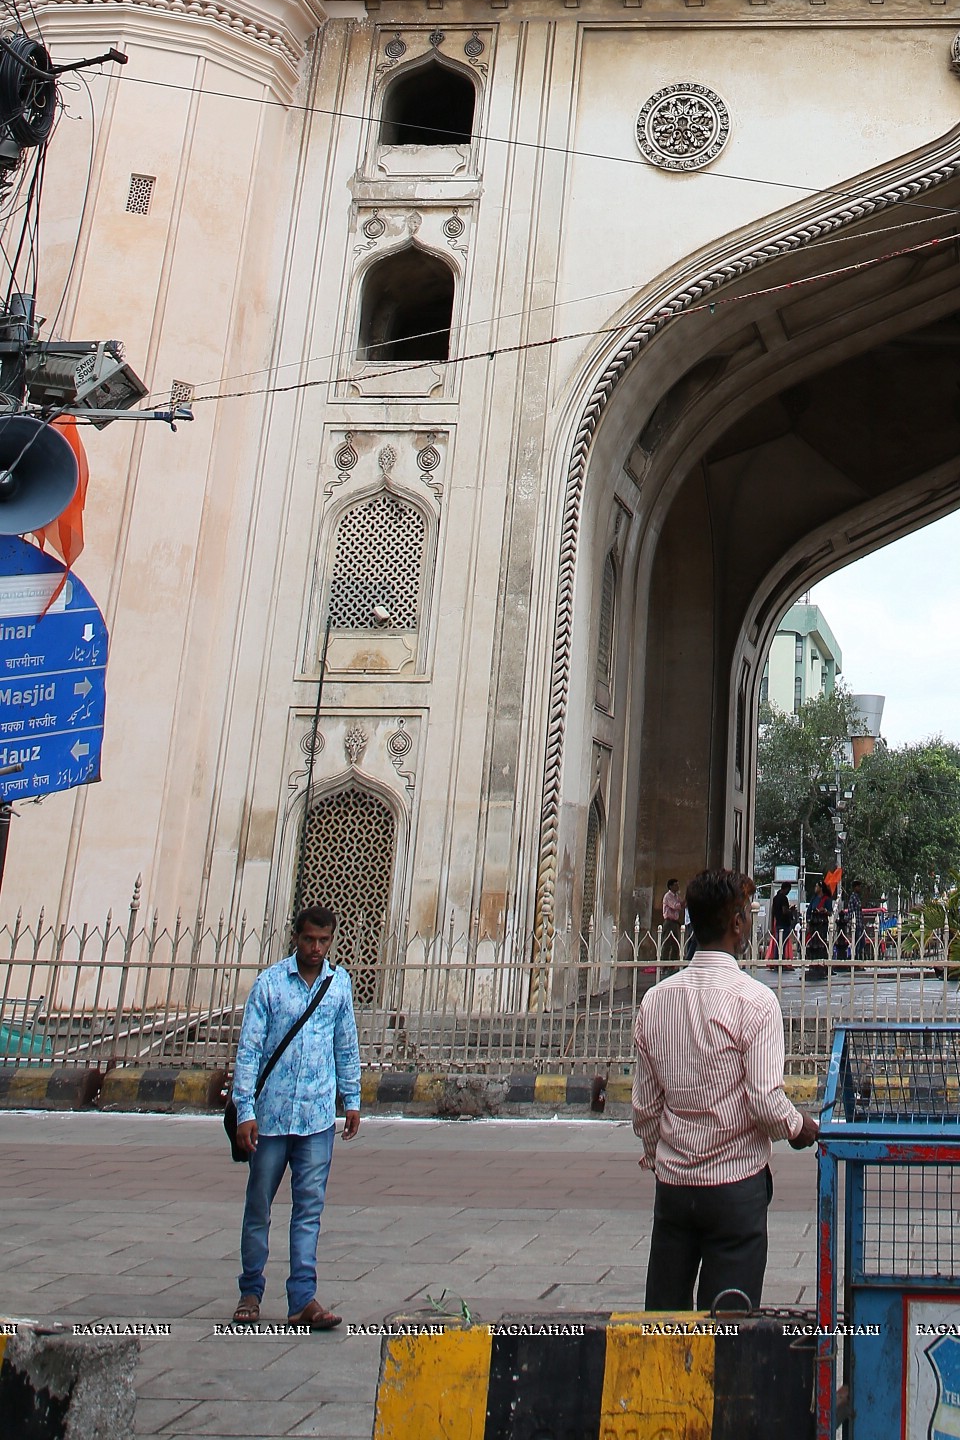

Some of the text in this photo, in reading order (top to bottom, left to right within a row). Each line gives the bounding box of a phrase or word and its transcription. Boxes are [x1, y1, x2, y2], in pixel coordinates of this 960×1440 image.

[76, 355, 97, 374] SAYEED
[78, 362, 96, 380] SOUN
[5, 653, 46, 669] चारमीनार
[0, 682, 56, 707] Masjid
